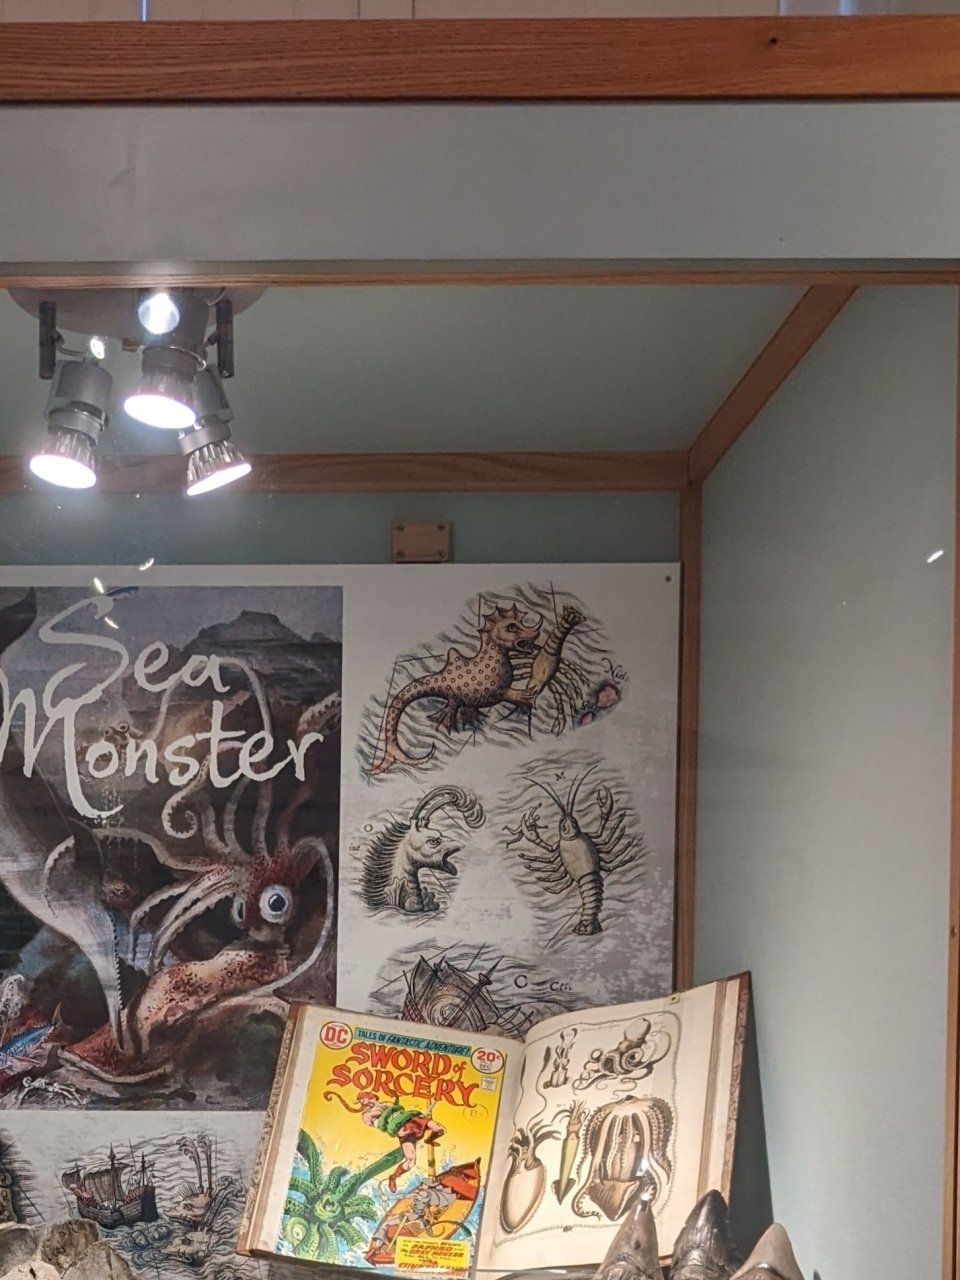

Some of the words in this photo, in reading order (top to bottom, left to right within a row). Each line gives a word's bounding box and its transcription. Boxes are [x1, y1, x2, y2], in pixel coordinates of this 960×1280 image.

[40, 596, 230, 716] Sea
[324, 1026, 349, 1044] DC
[358, 1029, 378, 1041] TALES
[379, 1032, 387, 1042] OF
[387, 1033, 423, 1049] FANTASTIC
[345, 1041, 453, 1078] SWORD
[453, 1061, 467, 1081] of
[326, 1063, 480, 1108] SORCERY
